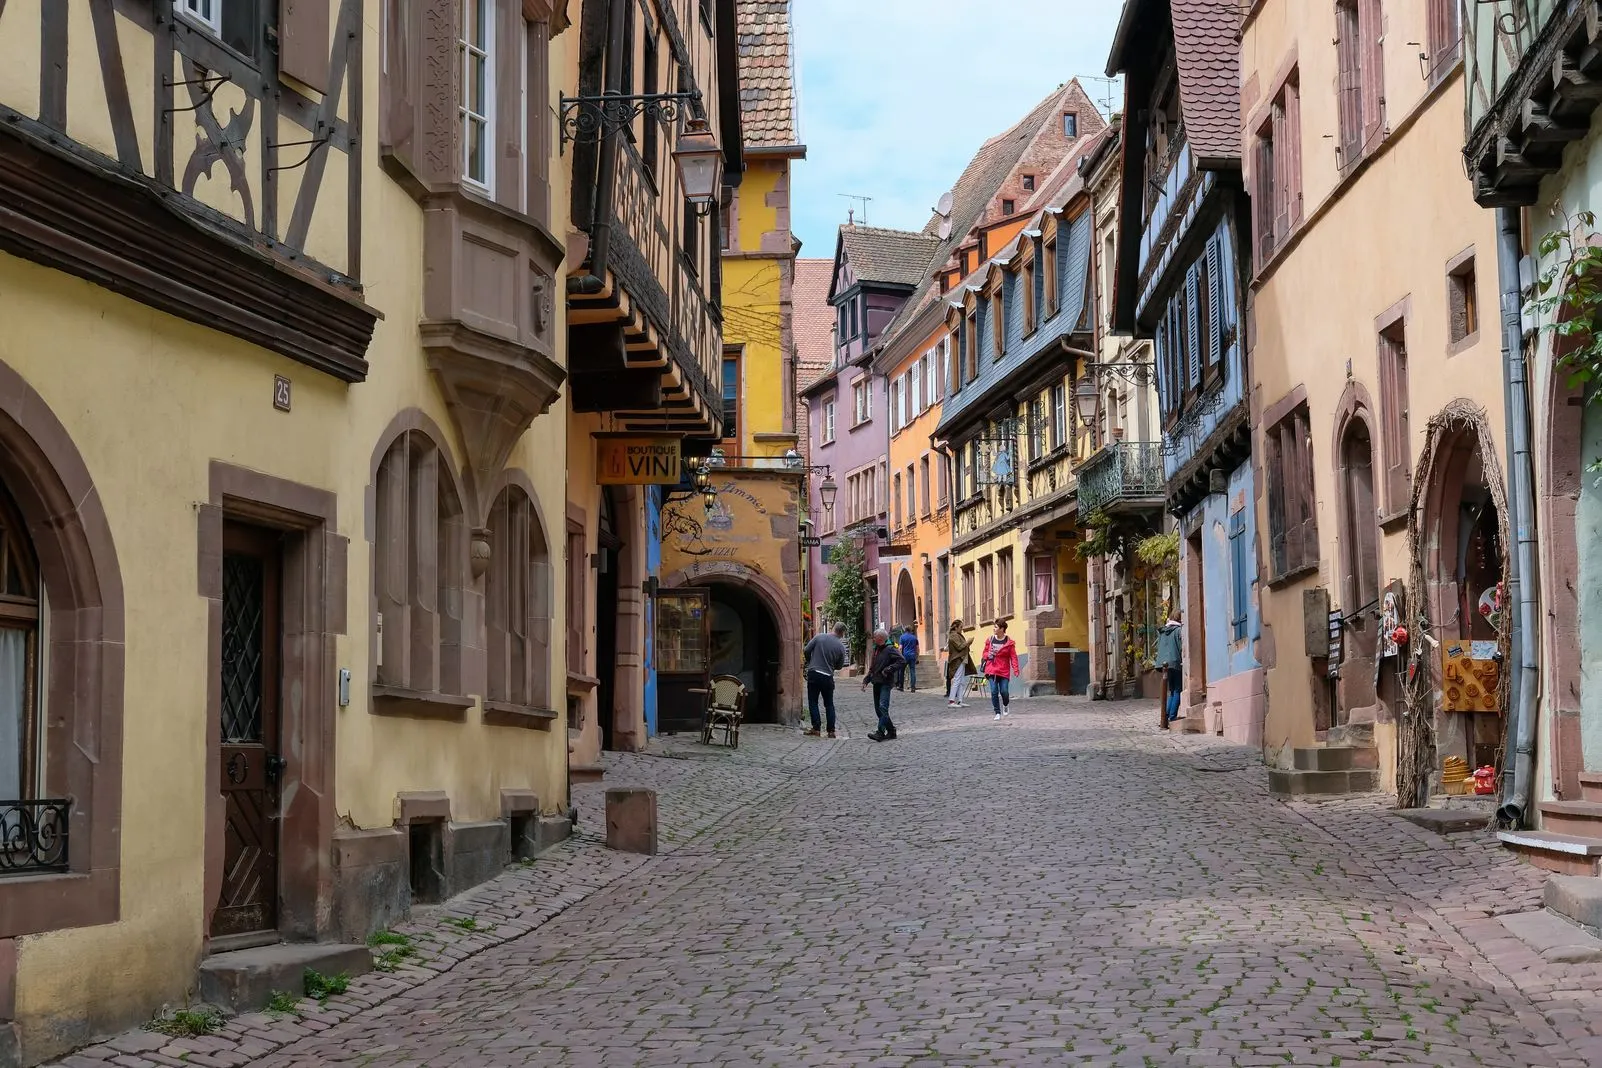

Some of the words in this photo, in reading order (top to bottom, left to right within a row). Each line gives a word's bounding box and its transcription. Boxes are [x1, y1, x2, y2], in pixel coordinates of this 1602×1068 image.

[277, 380, 289, 405] 25
[627, 445, 676, 455] BOUTIQUE
[628, 455, 677, 477] VINI
